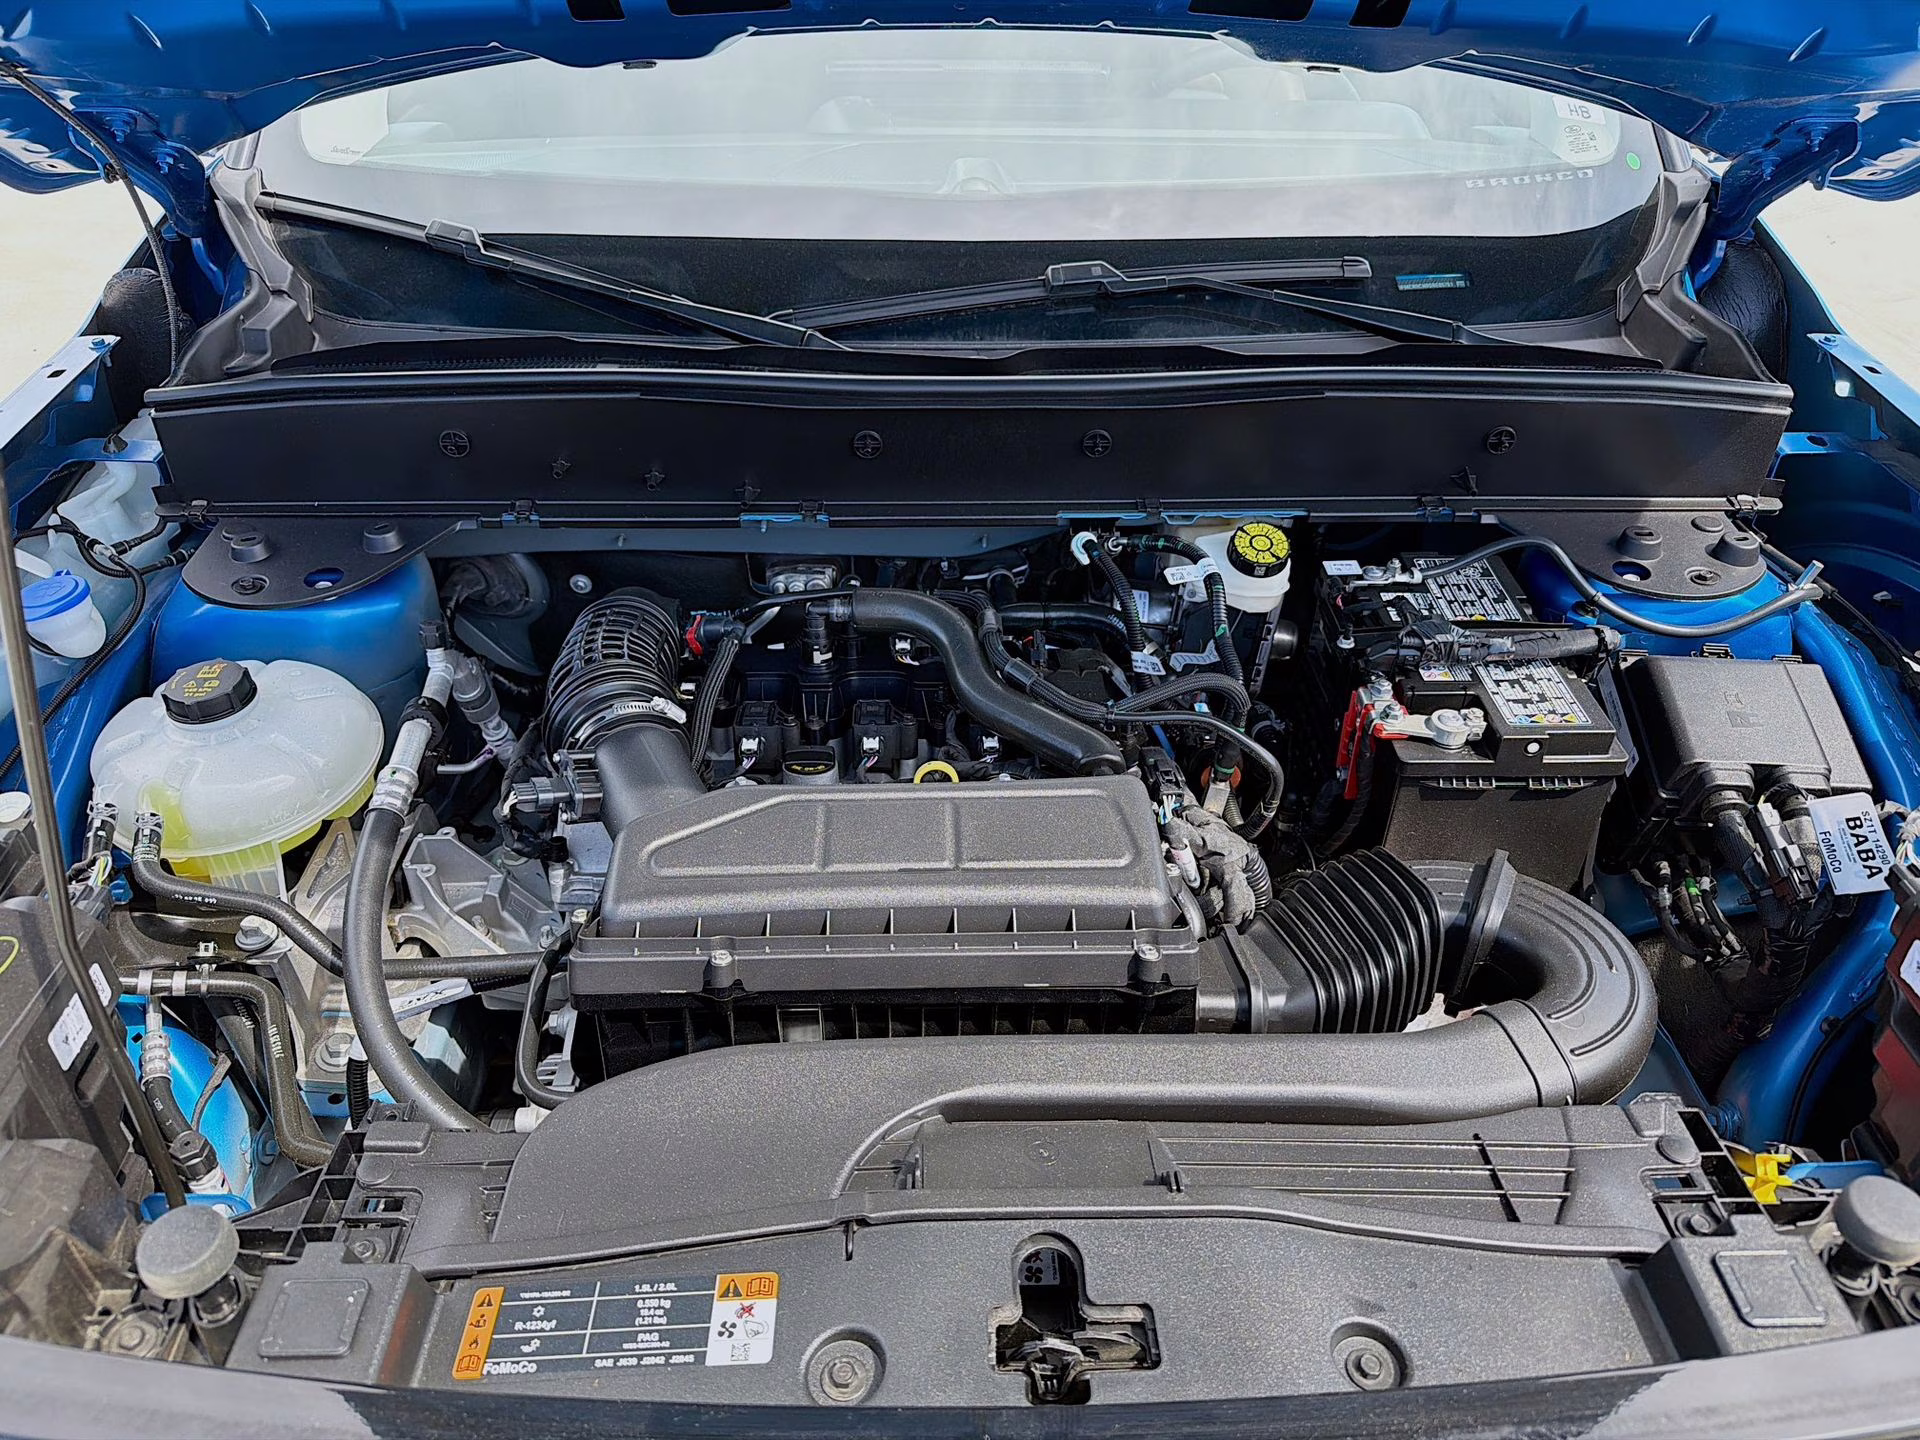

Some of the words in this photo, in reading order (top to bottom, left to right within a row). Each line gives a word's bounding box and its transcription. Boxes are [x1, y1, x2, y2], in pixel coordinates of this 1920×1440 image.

[1568, 103, 1591, 119] HB
[1465, 168, 1594, 188] BRONCO
[1819, 831, 1842, 873] FoMoCo
[1845, 816, 1883, 879] BABA
[1872, 838, 1891, 865] 14290
[634, 1284, 652, 1293] 1.5L
[658, 1282, 677, 1291] 2.0L
[660, 1298, 671, 1308] kg
[514, 1319, 557, 1331] R-1234yf
[637, 1332, 659, 1342] PAG
[482, 1360, 537, 1375] FoMoCo
[594, 1358, 614, 1368] SAE
